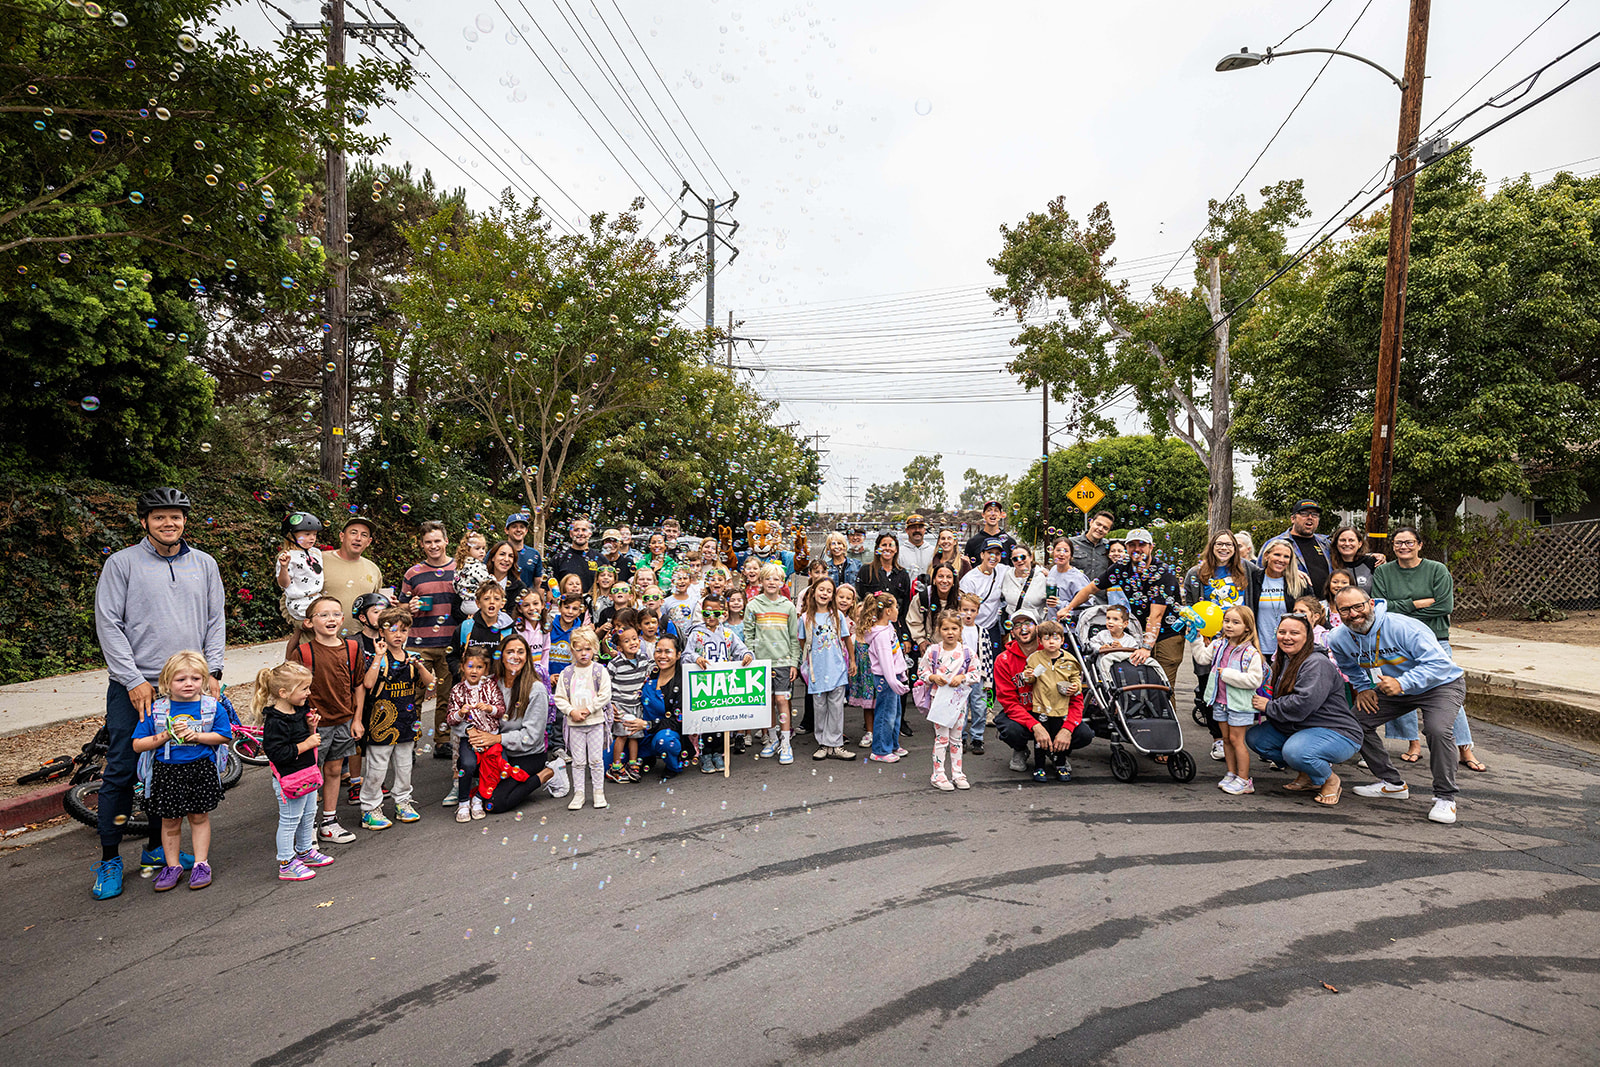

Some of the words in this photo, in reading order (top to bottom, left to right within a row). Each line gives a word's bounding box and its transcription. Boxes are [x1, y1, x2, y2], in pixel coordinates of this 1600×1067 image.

[1077, 491, 1095, 499] END
[690, 669, 765, 698] WALK
[695, 700, 707, 708] TO
[710, 696, 746, 707] SCHOOL
[748, 694, 765, 703] DAY
[701, 715, 713, 723] City
